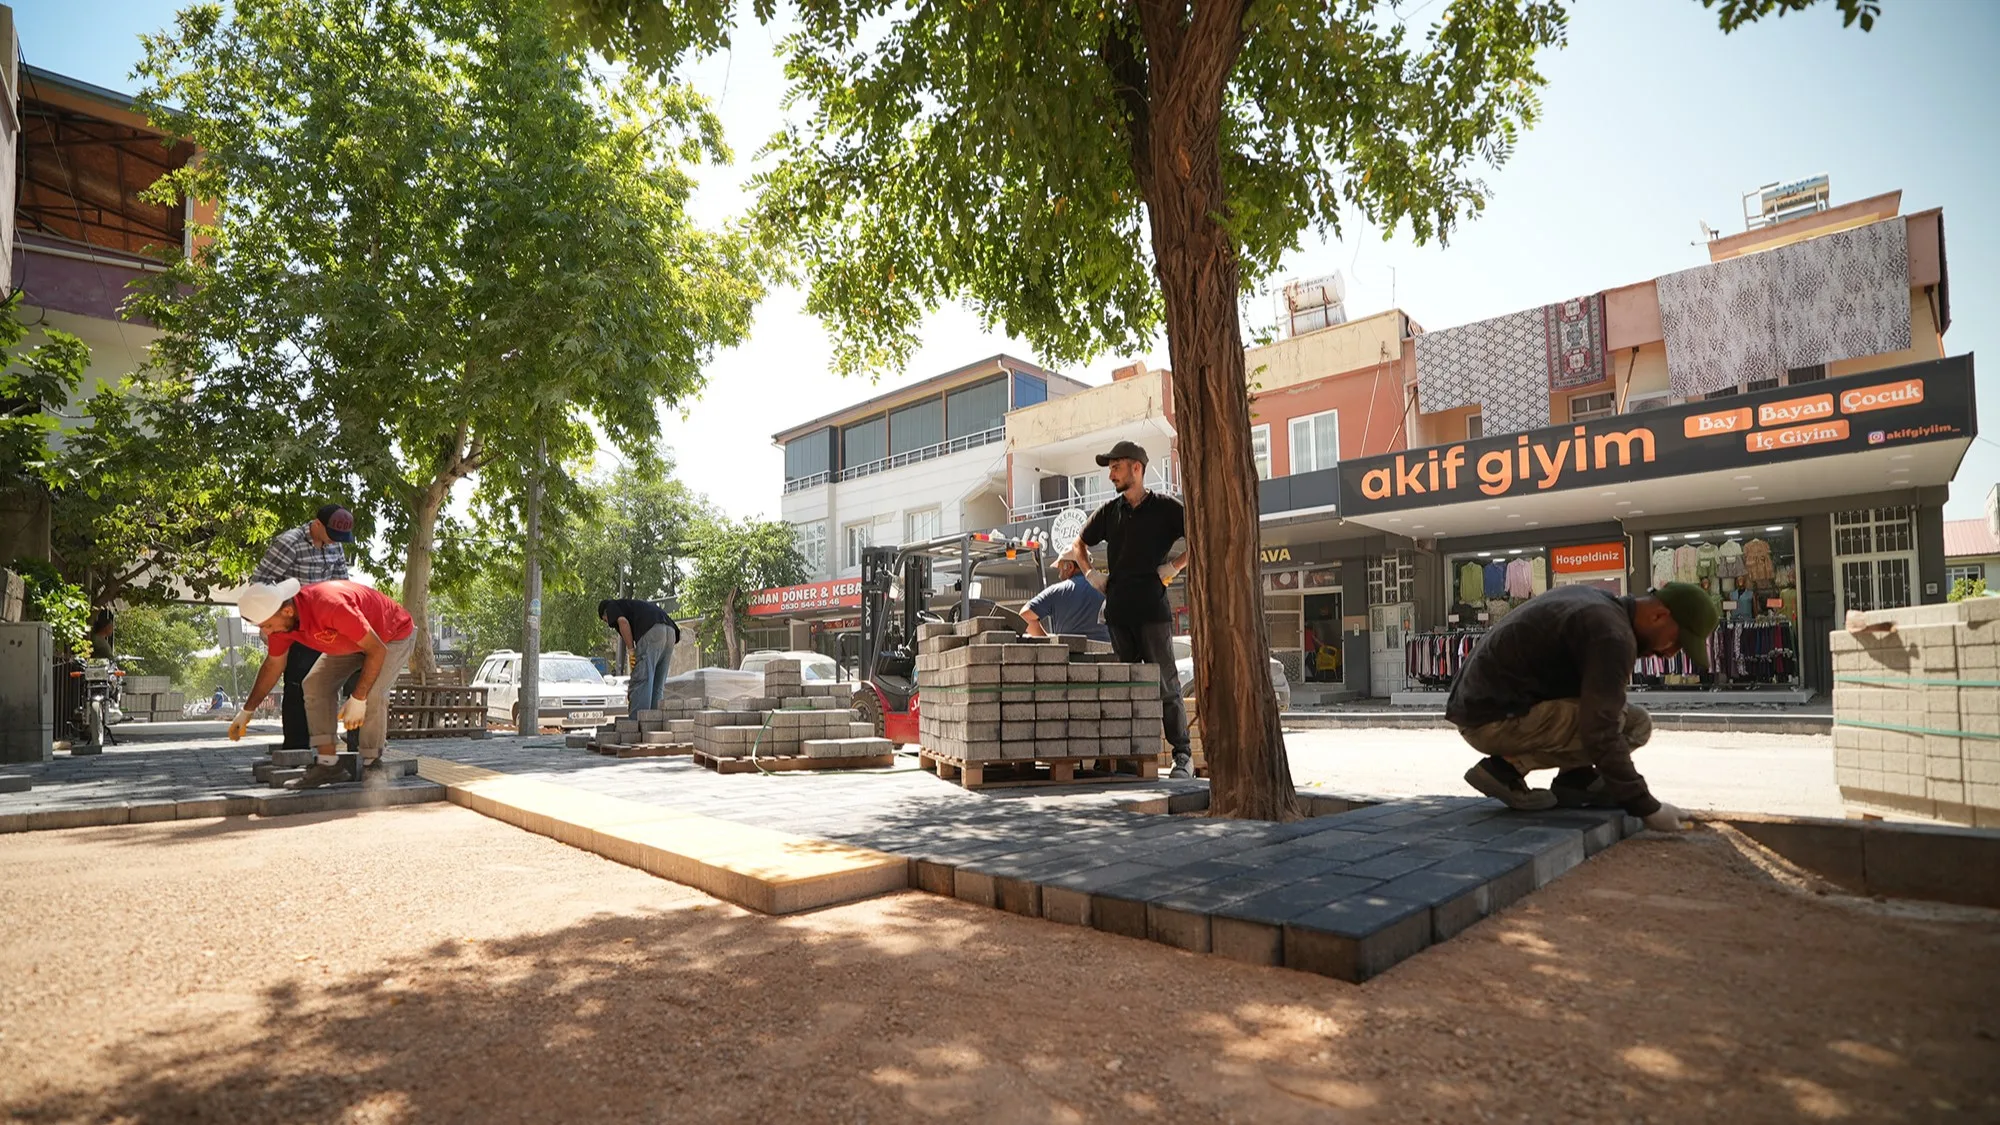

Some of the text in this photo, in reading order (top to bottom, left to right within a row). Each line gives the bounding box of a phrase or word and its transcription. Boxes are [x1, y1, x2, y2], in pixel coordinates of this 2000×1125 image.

[1698, 383, 1921, 431] Bay Bayan Çocuk
[1755, 426, 1838, 450] İç Giyim
[1360, 425, 1656, 500] akif giyim
[1261, 548, 1291, 563] AVA
[1556, 551, 1619, 565] Hoşgeldiniz
[782, 587, 817, 602] DÖNER
[820, 587, 829, 598] &
[832, 582, 862, 597] KEBA
